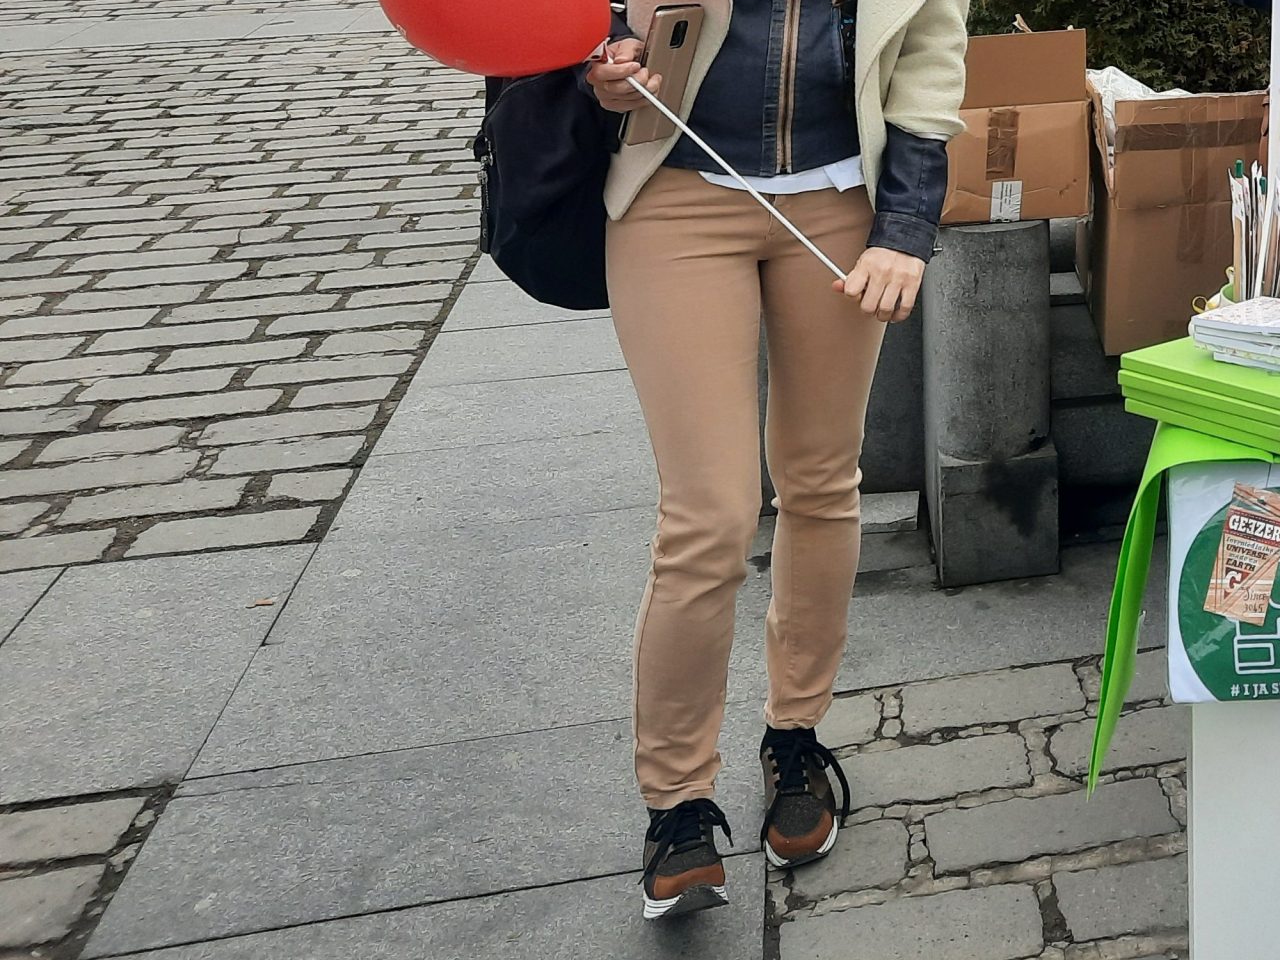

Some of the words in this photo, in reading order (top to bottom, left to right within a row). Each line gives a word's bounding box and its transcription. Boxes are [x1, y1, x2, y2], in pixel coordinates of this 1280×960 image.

[1226, 544, 1269, 560] UNIVERSE
[1225, 558, 1257, 572] EARTH
[1243, 683, 1250, 695] I
[1252, 683, 1269, 698] JA
